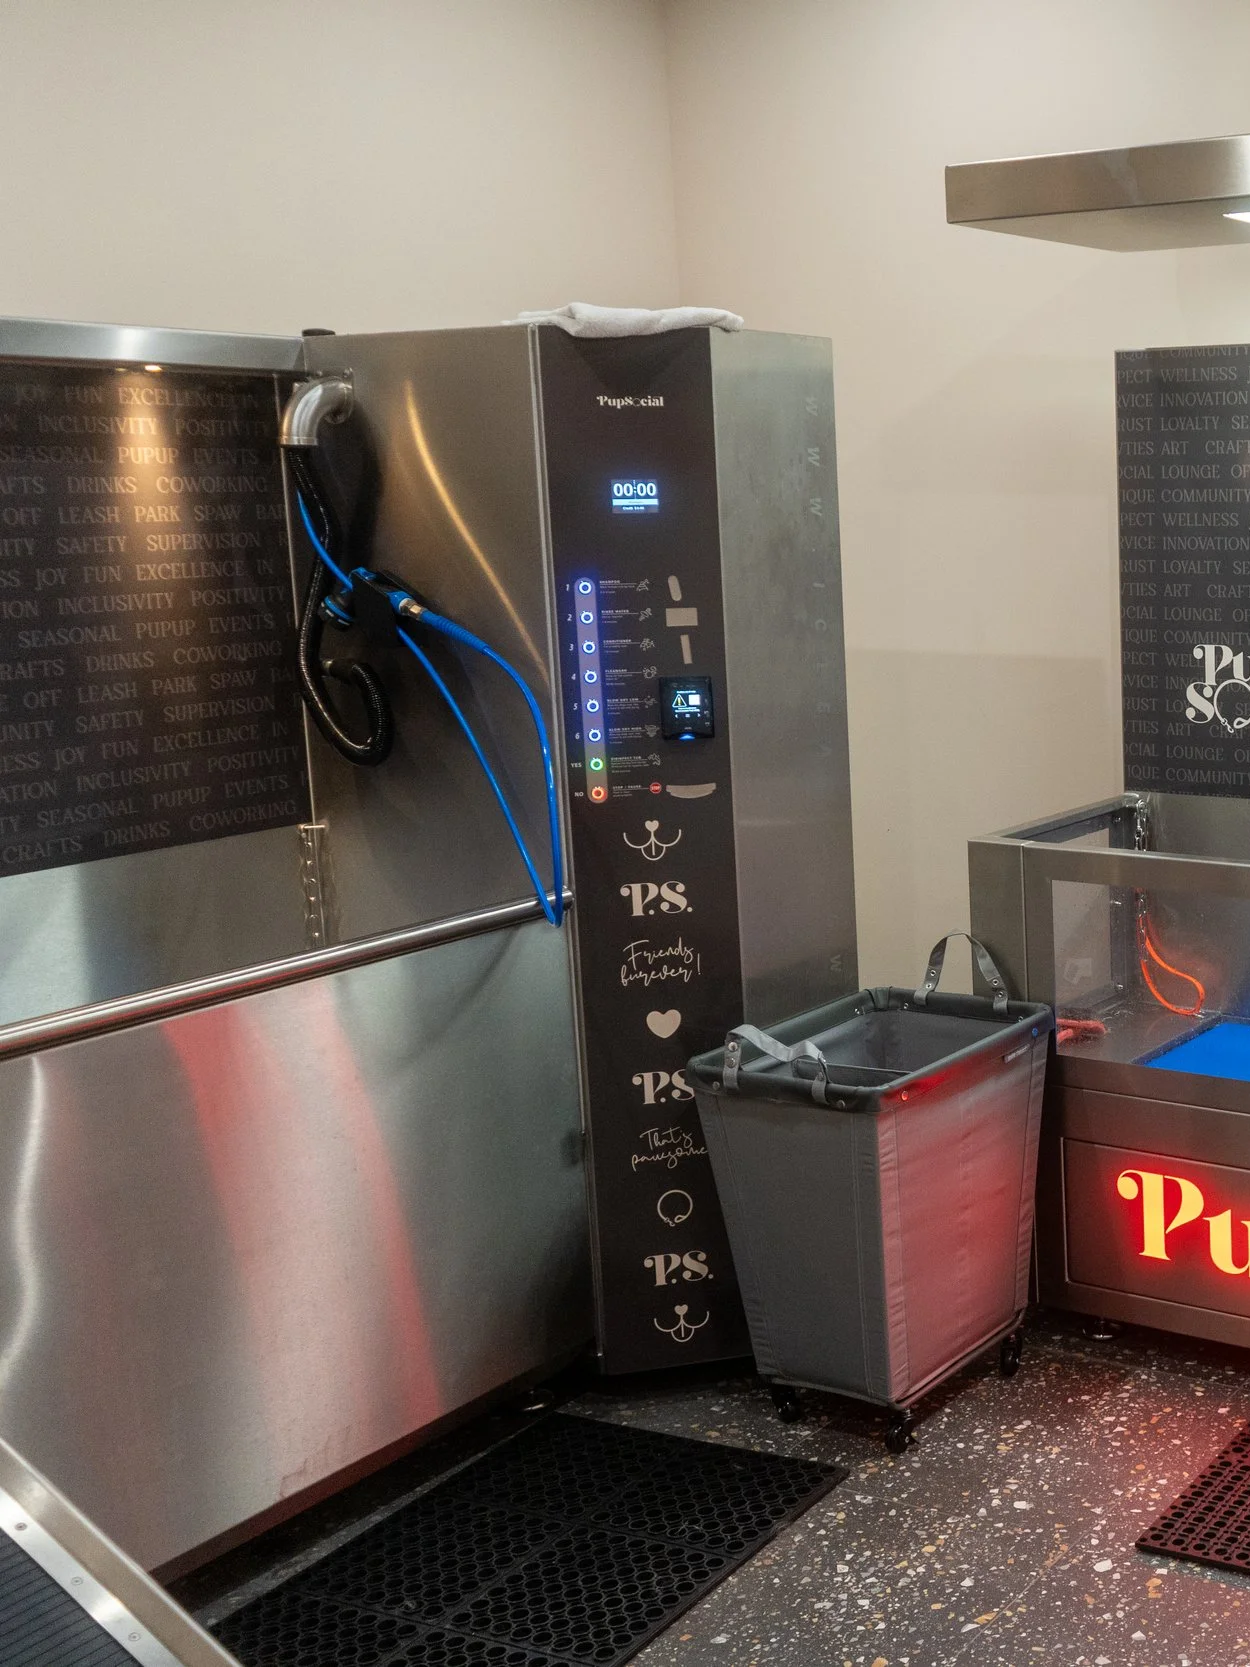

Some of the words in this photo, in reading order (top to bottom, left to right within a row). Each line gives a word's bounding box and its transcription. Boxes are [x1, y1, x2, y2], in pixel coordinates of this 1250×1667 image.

[1160, 365, 1238, 382] WELLNESS
[596, 395, 665, 409] PupSocial
[1160, 390, 1249, 407] INNOVATION
[38, 414, 158, 436] INCLUSIVITY
[1160, 415, 1220, 432] LOYALTY
[118, 446, 179, 465] PUPUP
[1161, 441, 1190, 456] ART
[1161, 464, 1220, 479] LOUNGE
[66, 475, 138, 494] DRINKS
[155, 475, 268, 494] COWORKING
[613, 482, 657, 497] 00:00
[57, 505, 121, 525] LEASH
[134, 504, 181, 523] PARK
[193, 504, 242, 522] SPAW
[56, 535, 127, 555] SAFETY
[146, 531, 261, 553] SUPERVISION
[1162, 536, 1250, 551] INNOVATION
[83, 565, 122, 584] FUN
[135, 560, 245, 582] EXCELLENCE
[565, 583, 571, 592] 1
[57, 591, 175, 616] INCLUSIVITY
[567, 613, 573, 622] 2
[18, 624, 122, 649] SEASONAL
[135, 619, 196, 641] PUPUP
[208, 612, 276, 635] EVENTS
[86, 650, 156, 674] DRINKS
[172, 639, 283, 666] COWORKING
[569, 643, 575, 652] 3
[571, 673, 577, 681] 4
[76, 681, 139, 704] LEASH
[151, 674, 198, 696] PARK
[163, 696, 276, 724] SUPERVISION
[573, 702, 579, 711] 5
[153, 723, 260, 753] EXCELLENCE
[574, 732, 581, 740] 6
[620, 880, 693, 917] P.S.
[622, 936, 695, 971] Friends
[631, 1068, 696, 1105] P.S
[639, 1126, 693, 1151] That's
[643, 1250, 714, 1287] P.S.
